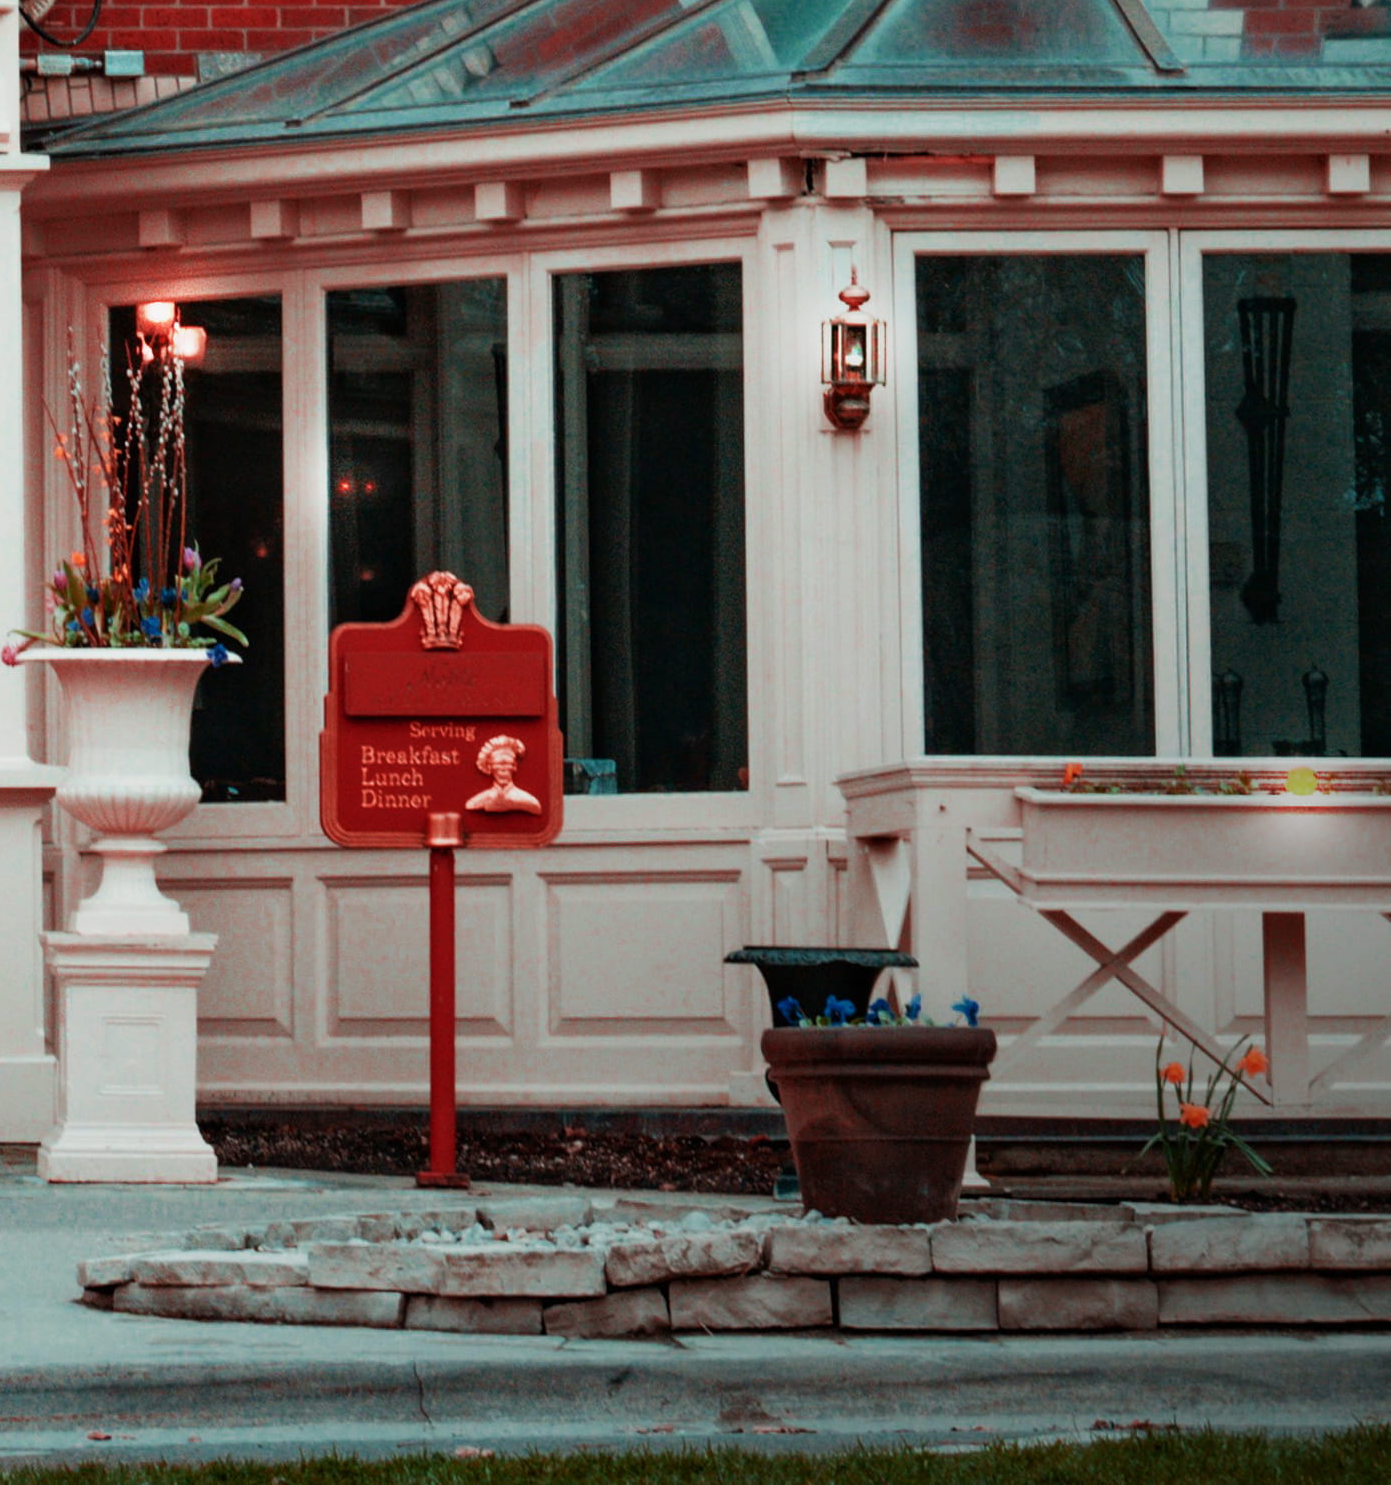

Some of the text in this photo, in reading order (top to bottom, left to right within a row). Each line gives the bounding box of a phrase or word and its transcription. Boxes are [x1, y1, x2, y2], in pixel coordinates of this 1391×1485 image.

[409, 721, 476, 742] Serving
[361, 745, 460, 765] Breakfast
[361, 767, 424, 787] Lunch
[361, 789, 432, 809] Dinner
